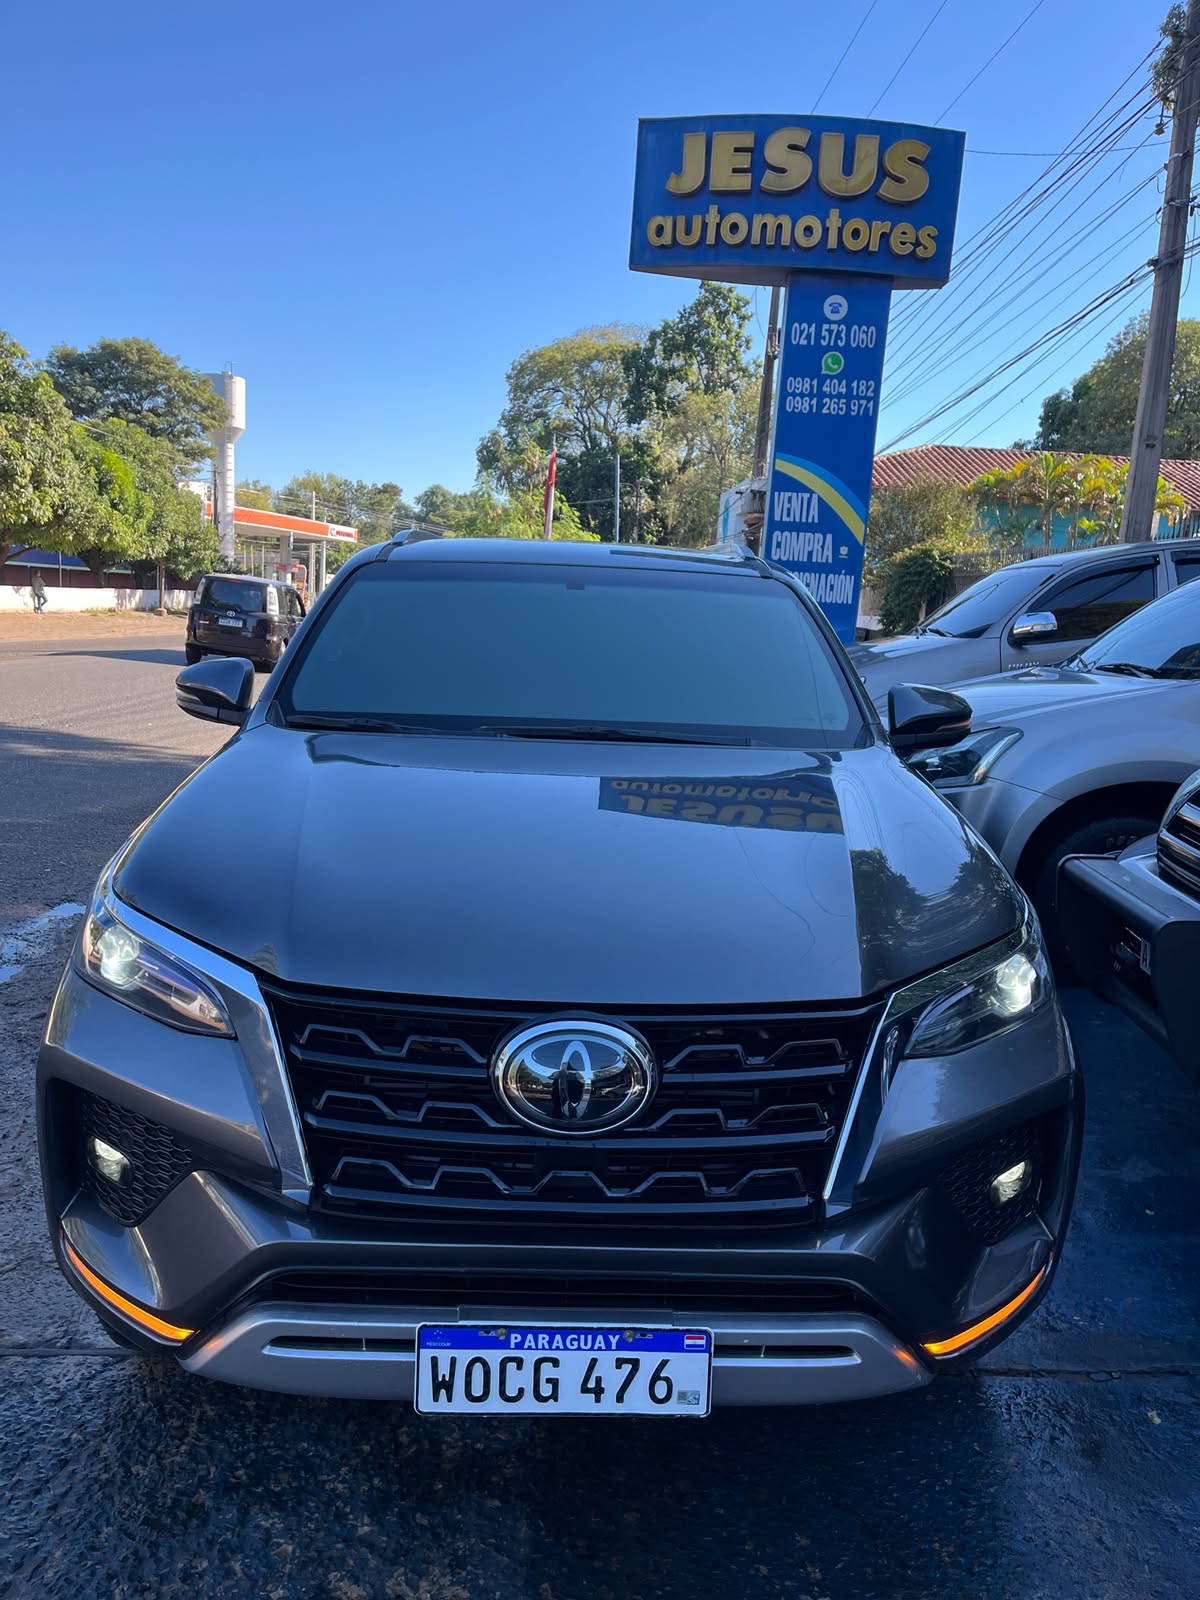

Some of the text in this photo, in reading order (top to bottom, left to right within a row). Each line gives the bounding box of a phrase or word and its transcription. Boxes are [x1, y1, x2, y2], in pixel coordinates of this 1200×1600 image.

[665, 127, 931, 204] JESUS
[646, 204, 939, 259] automotores
[791, 322, 876, 348] 021 573 060
[786, 377, 875, 397] 0981 404 182
[786, 396, 874, 416] 0981 265 971
[774, 491, 819, 523] VENTA
[771, 531, 833, 563] COMPRA
[791, 569, 855, 604] GNACIÓN
[510, 1333, 621, 1350] PARAGUAY
[430, 1355, 674, 1404] WOCG 476
